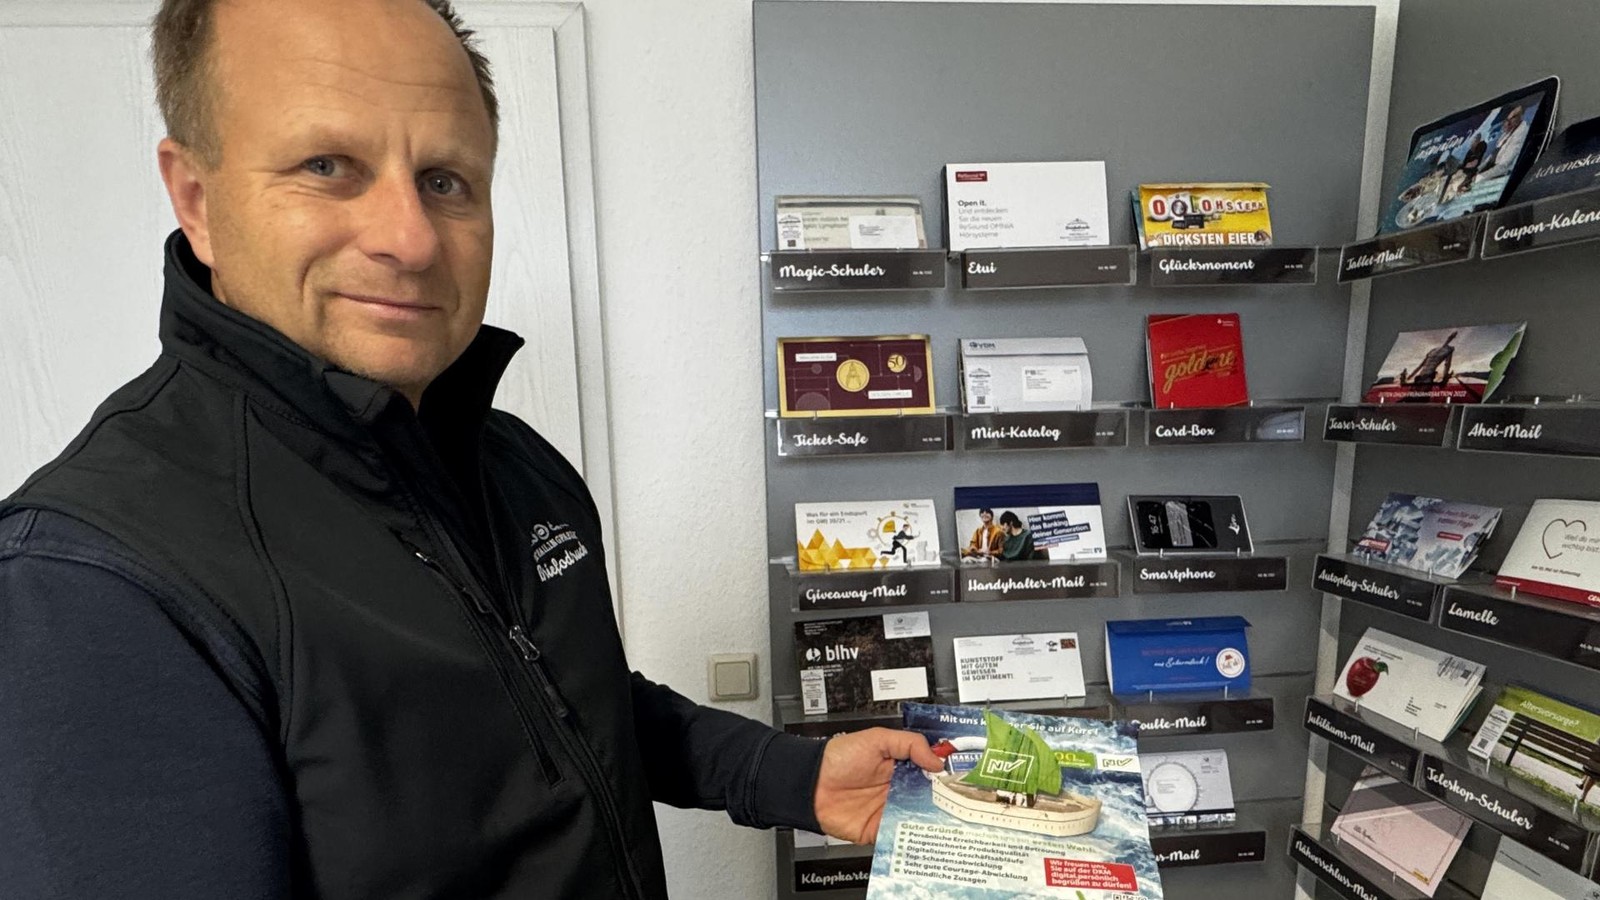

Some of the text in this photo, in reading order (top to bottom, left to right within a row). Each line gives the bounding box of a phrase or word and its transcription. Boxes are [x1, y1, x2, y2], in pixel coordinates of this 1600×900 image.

[1163, 232, 1256, 246] DICKSTEN EIER
[1158, 258, 1255, 275] Glücksmoment
[1345, 246, 1406, 272] Tablet-Mail
[779, 263, 886, 281] Magic-Schuber
[967, 261, 997, 274] Etui
[887, 355, 906, 368] 50
[1155, 424, 1216, 438] Card-Box
[1328, 416, 1398, 432] Teaser-Schuber
[1467, 422, 1542, 440] Ahoi-Mail
[792, 432, 868, 447] Ticket-Safe
[970, 425, 1061, 441] Mini-Katalog
[1043, 512, 1066, 520] kommt
[1032, 524, 1089, 538] deiner Generation
[1043, 520, 1069, 529] Banking
[1139, 567, 1216, 583] Smartphone
[967, 575, 1085, 594] Handyhalter-Mail
[1317, 567, 1401, 601] Autoplay-Schuber
[805, 584, 907, 604] Giveaway-Mail
[1447, 601, 1500, 626] Lamelle
[825, 644, 859, 662] blhv
[962, 668, 996, 676] GEWISSEN
[940, 715, 957, 724] Mit
[959, 718, 978, 726] uns
[1029, 722, 1046, 731] Sie
[1048, 724, 1066, 733] auf
[1307, 711, 1376, 755] Jubiläums-Mail
[1427, 766, 1533, 831] Teleskop-Schuber
[900, 822, 925, 832] Gute
[926, 824, 964, 836] Gründe
[908, 831, 952, 841] Persönliche
[953, 837, 1006, 848] Erreichbarkeit
[906, 846, 1024, 864] Digitalisierte Geschäftsabläufe
[907, 838, 1030, 858] Ausgezeichnete Produktqualität
[801, 870, 870, 886] Klappkarte
[903, 868, 987, 884] Verbindliche Zusagen
[904, 860, 1028, 882] Sehr gute Courtage-Abwicklung
[1052, 878, 1091, 887] begrüßen
